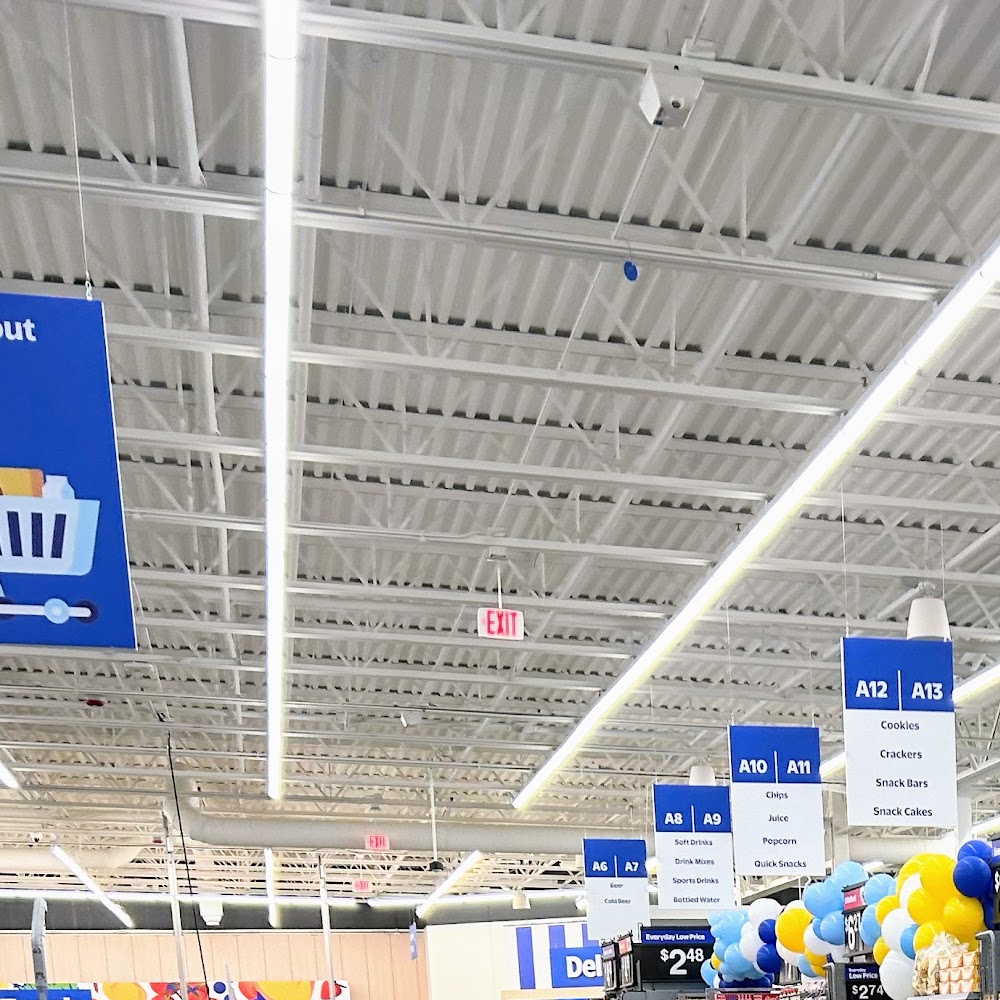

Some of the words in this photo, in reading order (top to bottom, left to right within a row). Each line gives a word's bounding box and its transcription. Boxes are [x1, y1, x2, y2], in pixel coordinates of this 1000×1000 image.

[486, 610, 518, 637] EXIT
[855, 680, 888, 699] A12
[911, 682, 943, 700] A13
[881, 720, 920, 731] Cookies
[880, 749, 922, 759] Crackers
[739, 759, 767, 774] A10
[786, 760, 811, 774] A11
[876, 778, 905, 788] Snack
[907, 779, 928, 788] Bars
[766, 791, 788, 800] Chips
[873, 807, 902, 817] Snack
[904, 807, 933, 817] Cakes
[665, 812, 683, 825] A8
[703, 813, 721, 825] A9
[768, 814, 788, 822] Juice
[763, 837, 797, 847] Popcorn
[592, 860, 608, 872] A6
[624, 861, 639, 872] A7
[754, 860, 777, 869] Quick
[779, 860, 807, 868] Snacks
[672, 877, 695, 885] Sports
[645, 933, 675, 941] Everyday
[689, 932, 706, 940] Price
[566, 955, 602, 978] Del
